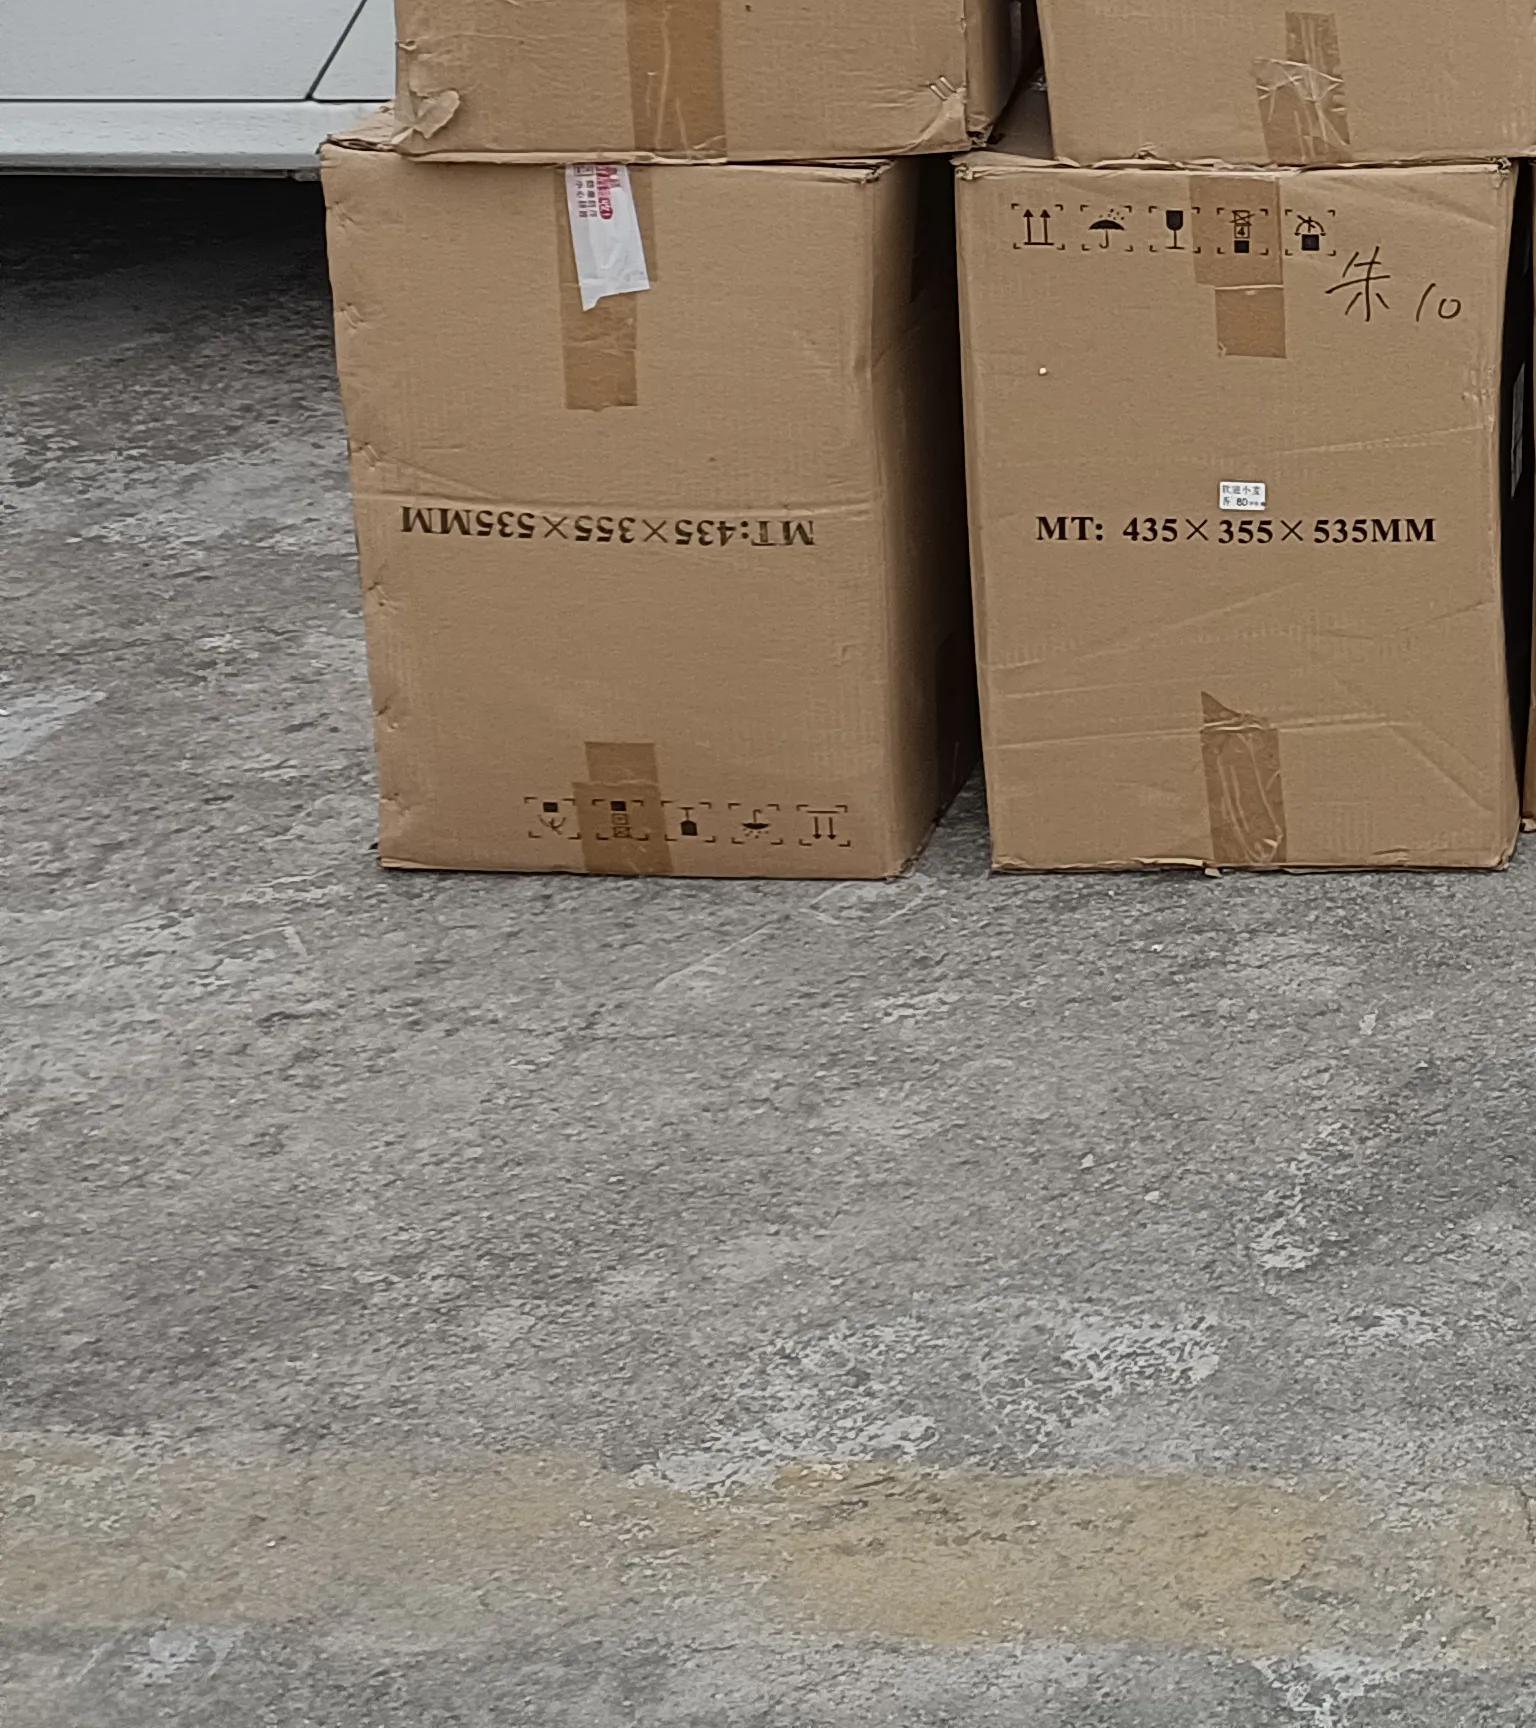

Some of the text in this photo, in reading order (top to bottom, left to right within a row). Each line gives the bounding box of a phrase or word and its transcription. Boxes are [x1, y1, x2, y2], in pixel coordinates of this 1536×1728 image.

[1324, 245, 1463, 323] 朱 10
[1035, 516, 1104, 543] MT:
